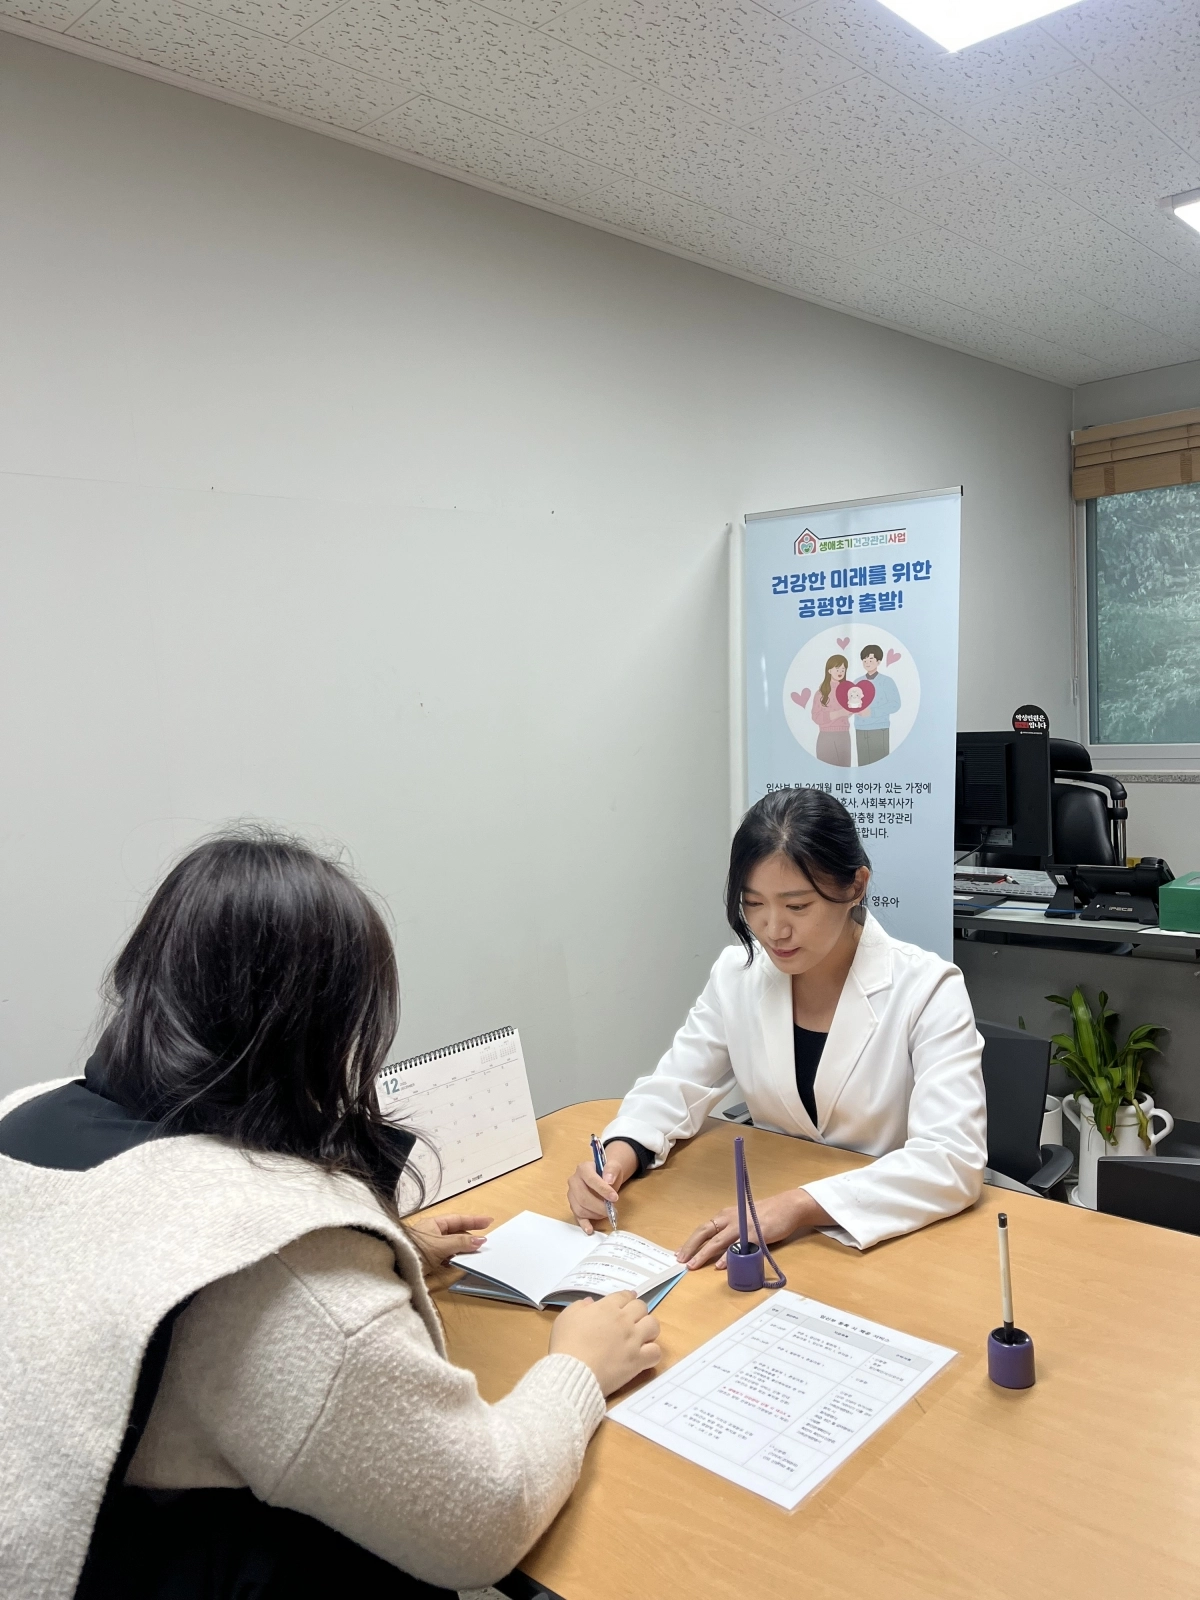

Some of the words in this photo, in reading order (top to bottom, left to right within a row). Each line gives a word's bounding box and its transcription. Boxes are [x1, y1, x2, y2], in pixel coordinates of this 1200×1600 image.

[771, 571, 826, 595] 건강한
[830, 564, 887, 589] 미래를
[892, 559, 932, 583] 위한
[798, 594, 854, 619] 공평한
[858, 590, 903, 614] 출발!
[836, 783, 853, 794] 미만
[856, 782, 882, 794] 영아가
[885, 782, 902, 794] 있는
[905, 782, 932, 794] 가정에
[836, 797, 859, 809] 호사,
[861, 797, 914, 809] 사회복지사가
[878, 812, 912, 824] 건강관리
[872, 895, 899, 908] 영유아
[383, 1078, 400, 1095] 12
